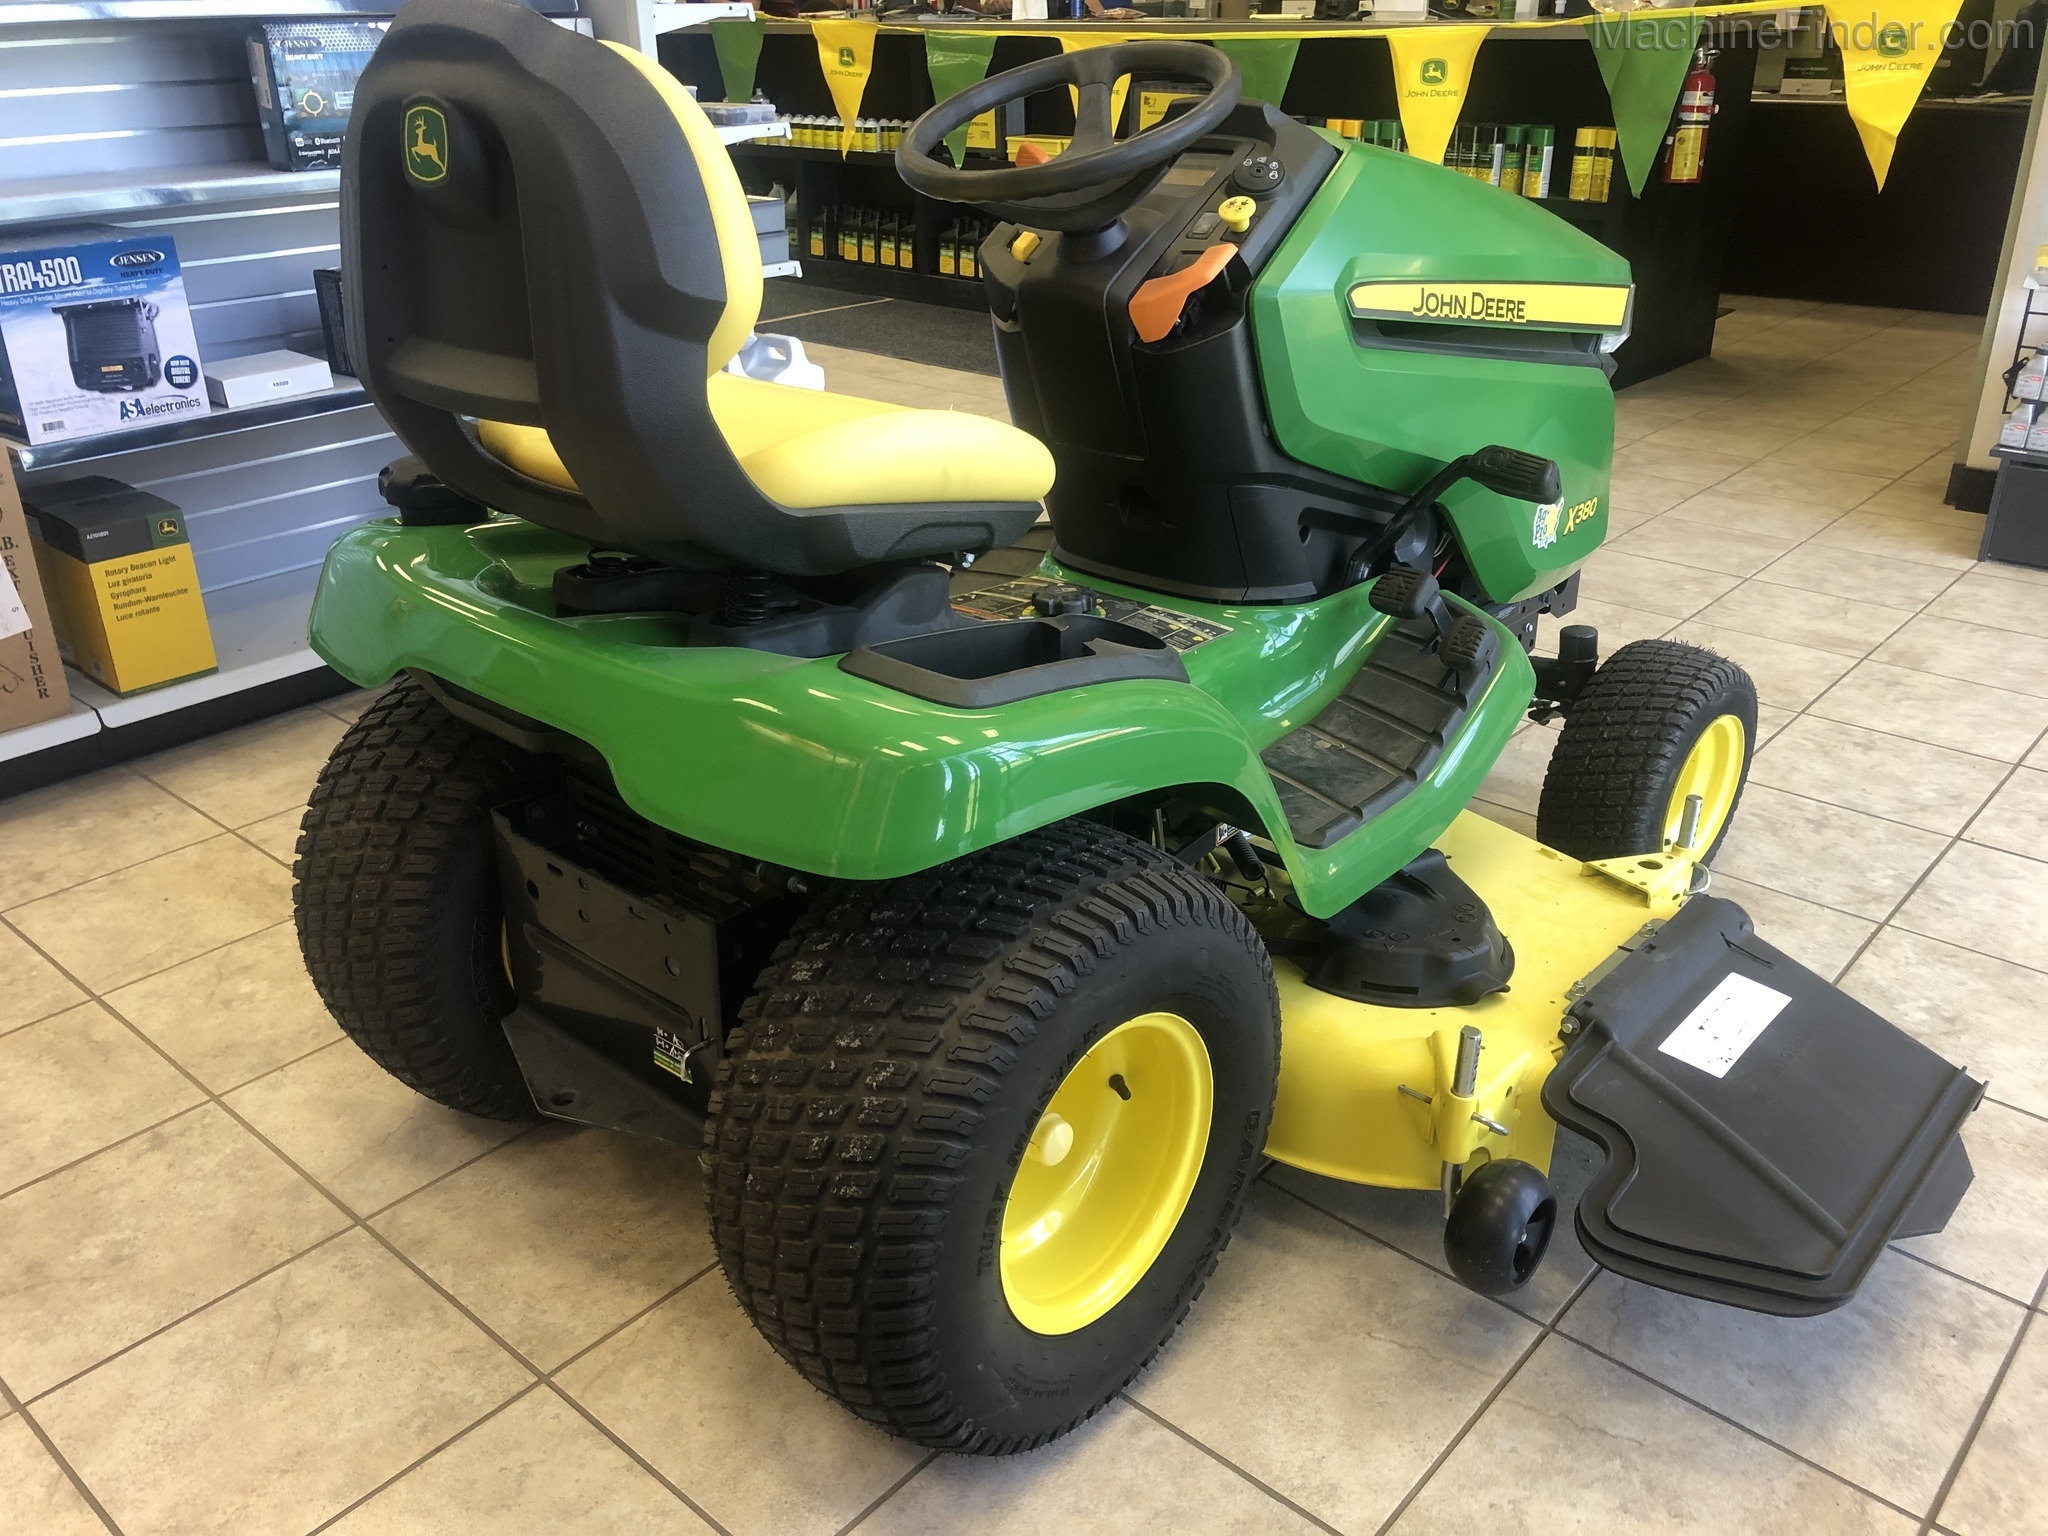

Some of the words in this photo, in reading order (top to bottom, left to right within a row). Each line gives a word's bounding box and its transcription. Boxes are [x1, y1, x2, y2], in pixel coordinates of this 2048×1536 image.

[828, 68, 844, 76] JOHN
[1857, 63, 1887, 72] JOHN
[1888, 61, 1924, 71] DEERE
[1405, 90, 1429, 98] JOHN
[1430, 89, 1459, 97] DEERE
[118, 252, 156, 265] JENSEN
[120, 269, 143, 278] HEAVY
[145, 267, 163, 275] DUTY
[1413, 287, 1467, 315] JOHN
[1471, 292, 1526, 320] DEERE
[1563, 496, 1598, 536] X380
[104, 565, 129, 577] Rotary
[130, 559, 157, 571] Beacon
[158, 555, 177, 565] Light
[107, 580, 121, 588] Luz
[122, 572, 153, 586] giratoria
[110, 585, 147, 600] Gyrophare
[113, 587, 189, 611] Rundum-Warnleuchte
[116, 613, 134, 622] Luce
[135, 605, 161, 618] rotante
[976, 1182, 1008, 1277] TURF
